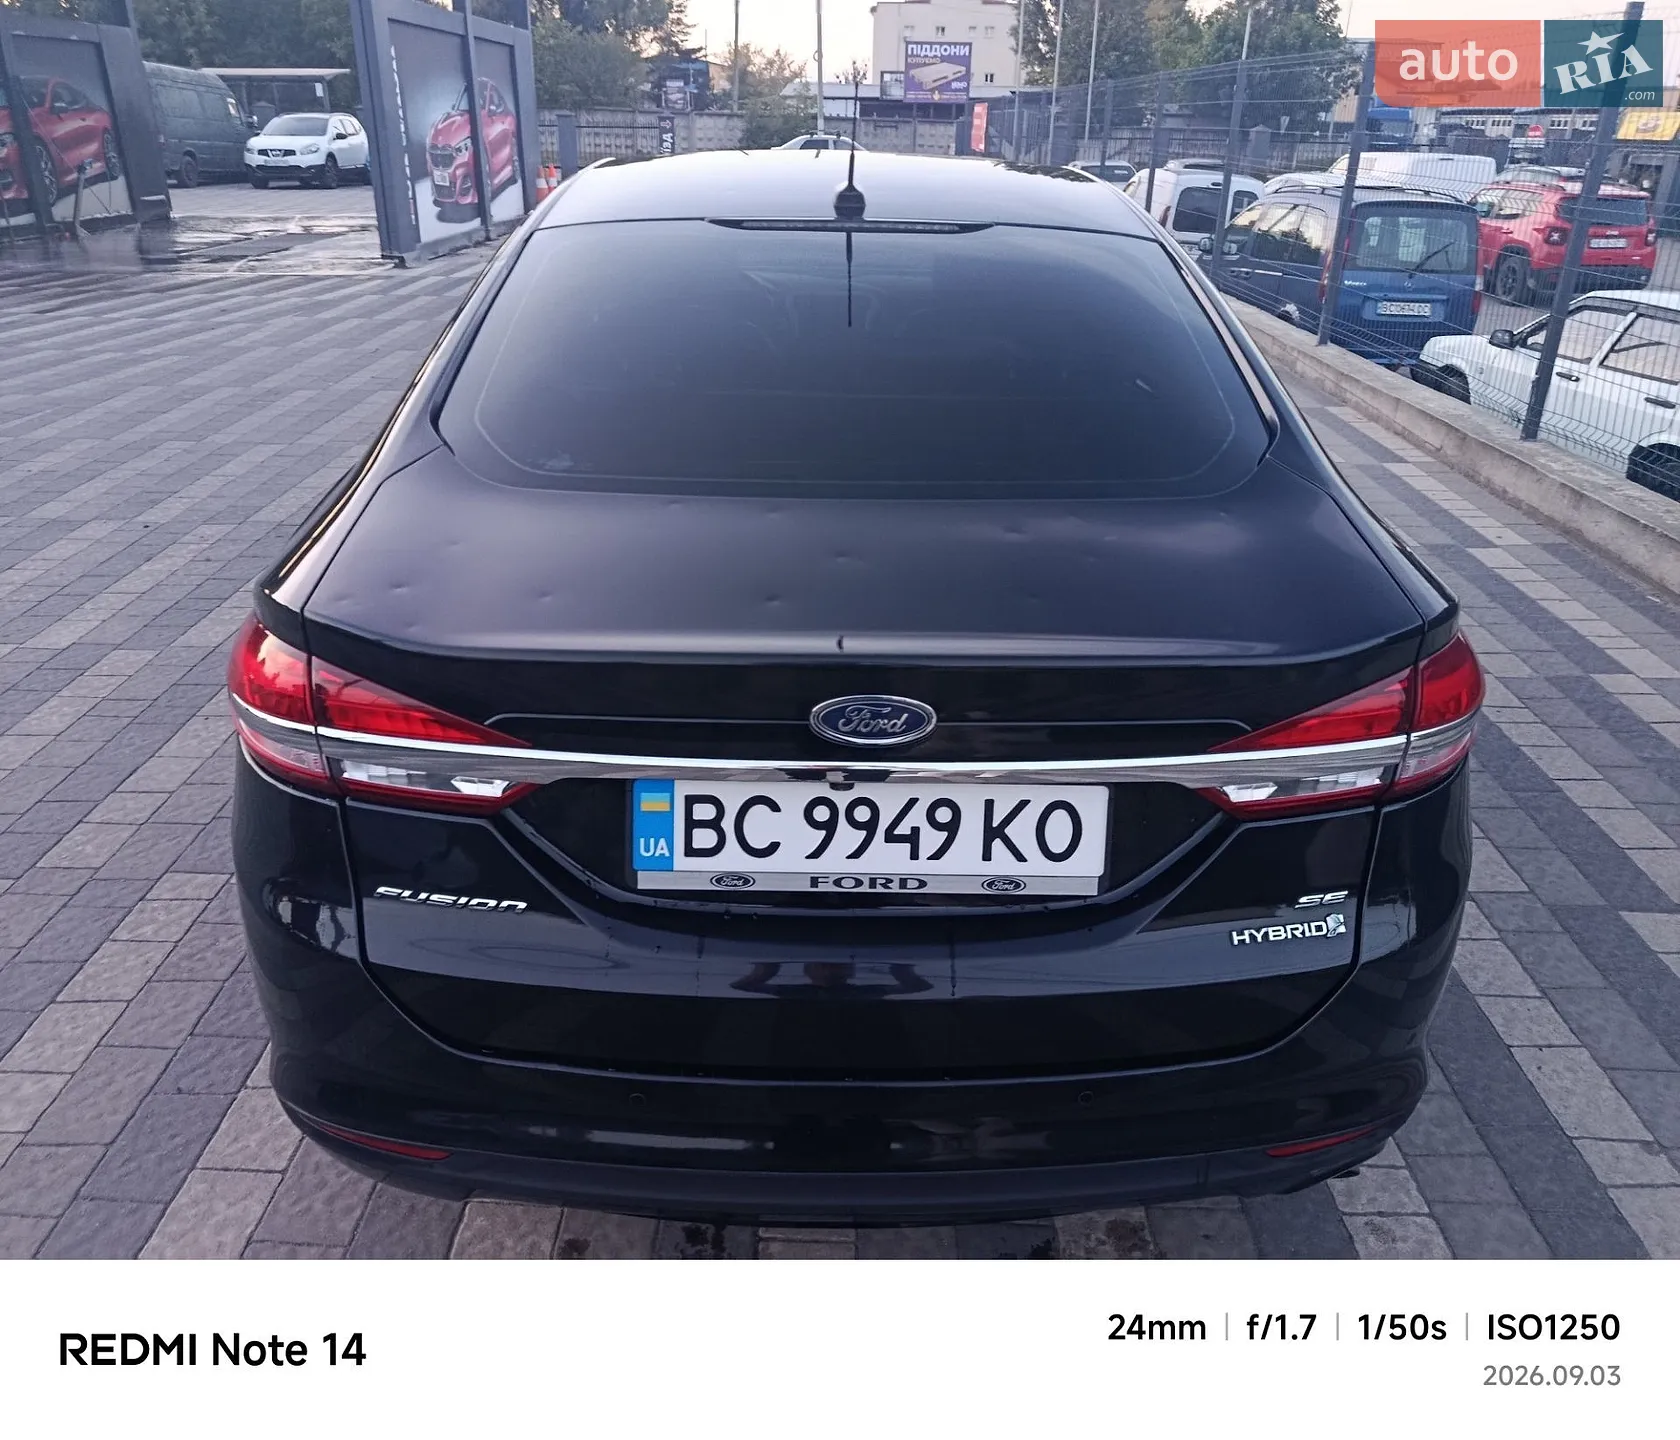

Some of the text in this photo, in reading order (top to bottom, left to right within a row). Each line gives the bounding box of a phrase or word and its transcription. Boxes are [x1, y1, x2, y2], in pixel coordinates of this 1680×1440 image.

[907, 44, 970, 57] ПІДДОНИ
[837, 704, 909, 733] Ford
[684, 794, 1083, 863] BC 9949 KO
[640, 837, 670, 858] UA
[809, 875, 928, 891] FORD
[1294, 890, 1349, 909] SE
[1231, 920, 1328, 946] HYBRID
